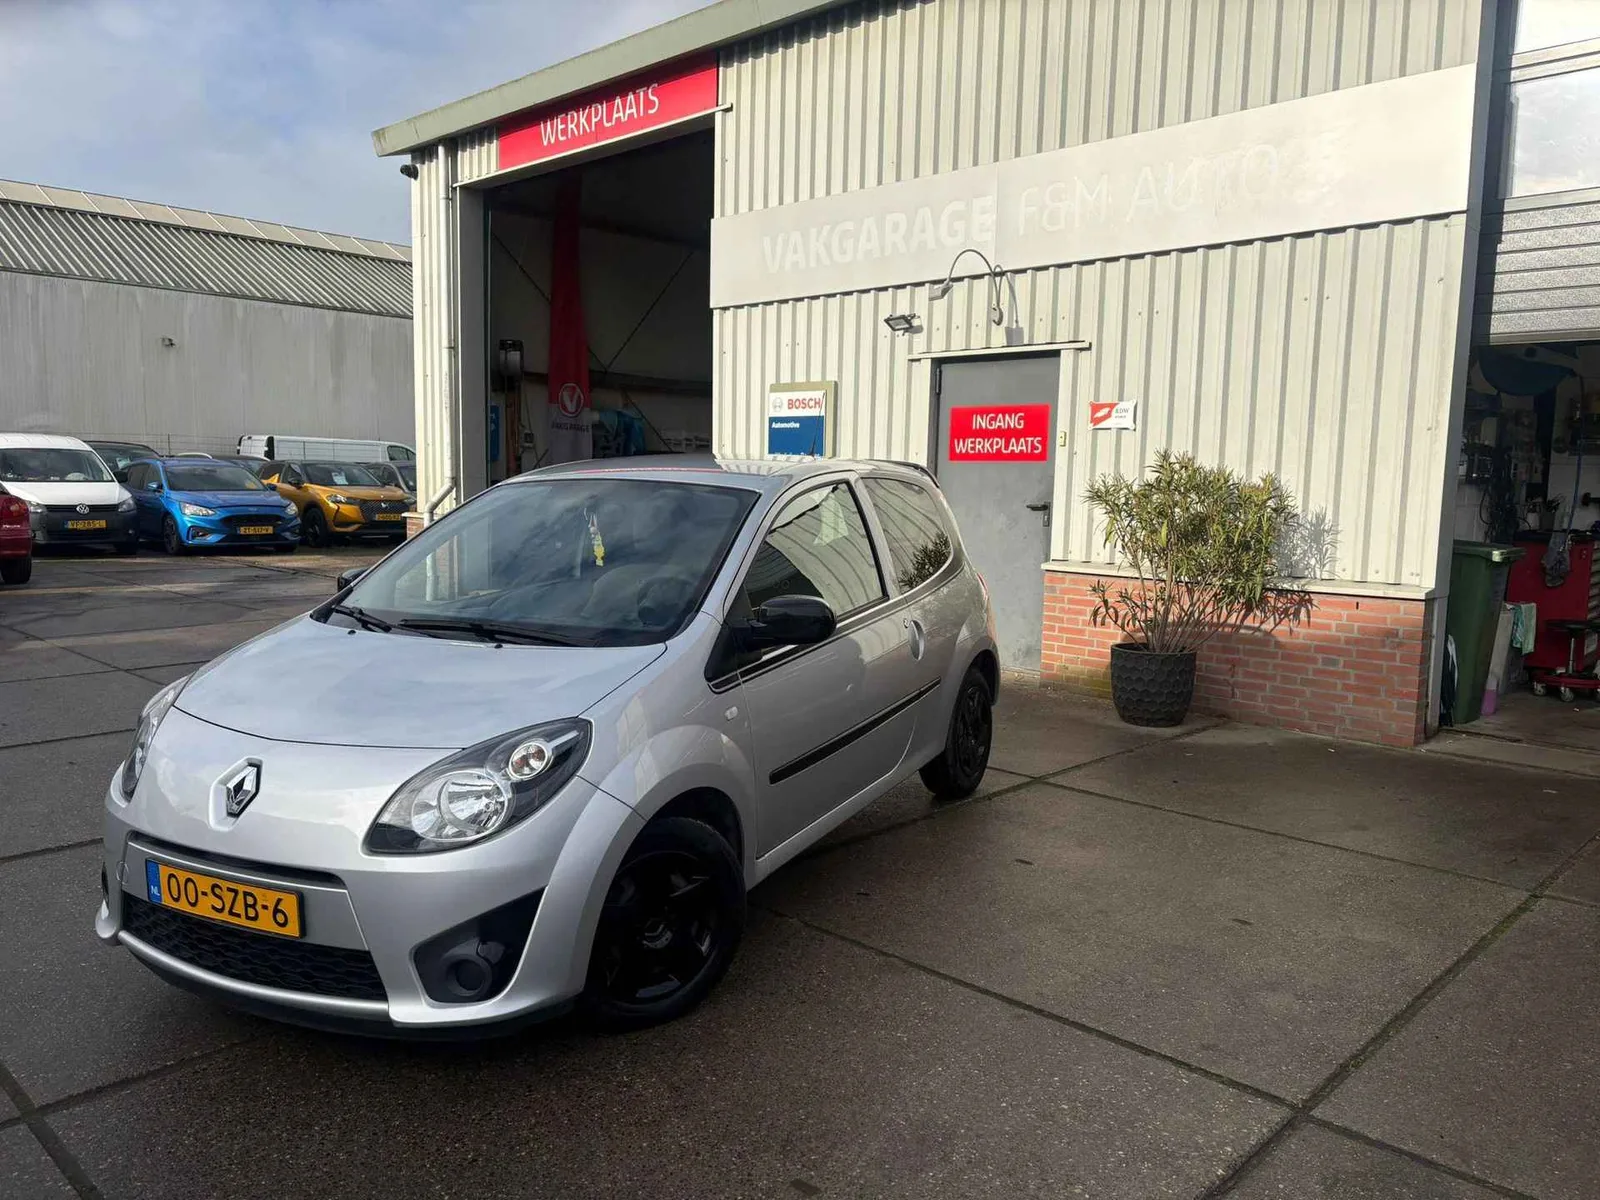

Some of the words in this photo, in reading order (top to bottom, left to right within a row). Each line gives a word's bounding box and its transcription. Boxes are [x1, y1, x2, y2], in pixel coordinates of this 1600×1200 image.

[540, 83, 660, 147] WERKPLAATS
[762, 195, 995, 275] VAKGARAGE
[787, 397, 821, 410] BOSCH
[972, 412, 1025, 430] INGANG
[954, 436, 1043, 454] WERKPLAATS
[150, 885, 161, 896] NL
[167, 872, 289, 928] 00-SZB-6
